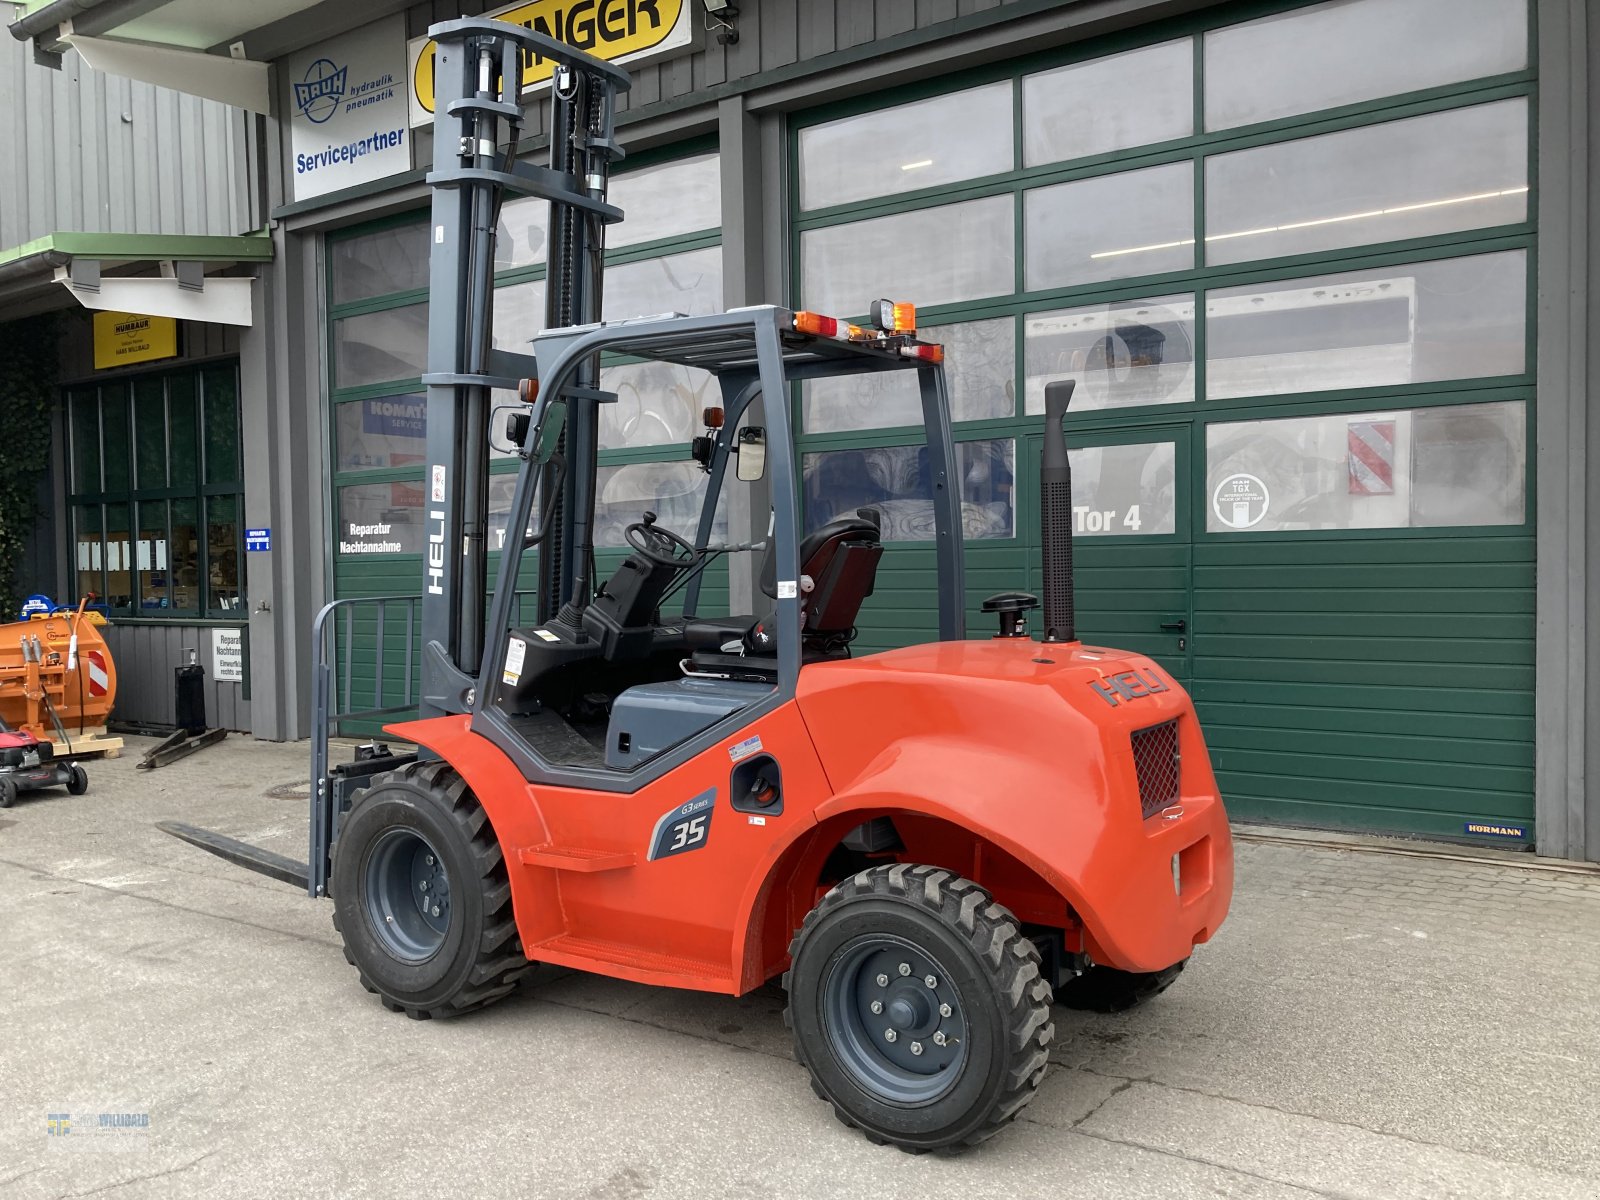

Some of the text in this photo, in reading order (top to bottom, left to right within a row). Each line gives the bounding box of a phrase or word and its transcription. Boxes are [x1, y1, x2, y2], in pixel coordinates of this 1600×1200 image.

[350, 74, 393, 96] hydraulik
[346, 88, 394, 113] pneumatik
[297, 128, 404, 174] Servicepartner
[115, 320, 149, 333] HUMBAUR
[392, 419, 423, 430] SERVICE
[1232, 485, 1250, 493] TGX
[1073, 504, 1141, 532] Tor 4
[349, 523, 391, 538] Reparatur
[340, 540, 402, 554] Nachtannahme
[428, 510, 445, 595] HELI
[1086, 668, 1170, 707] HELI
[681, 799, 709, 815] G3 SERIES
[670, 815, 707, 851] 35
